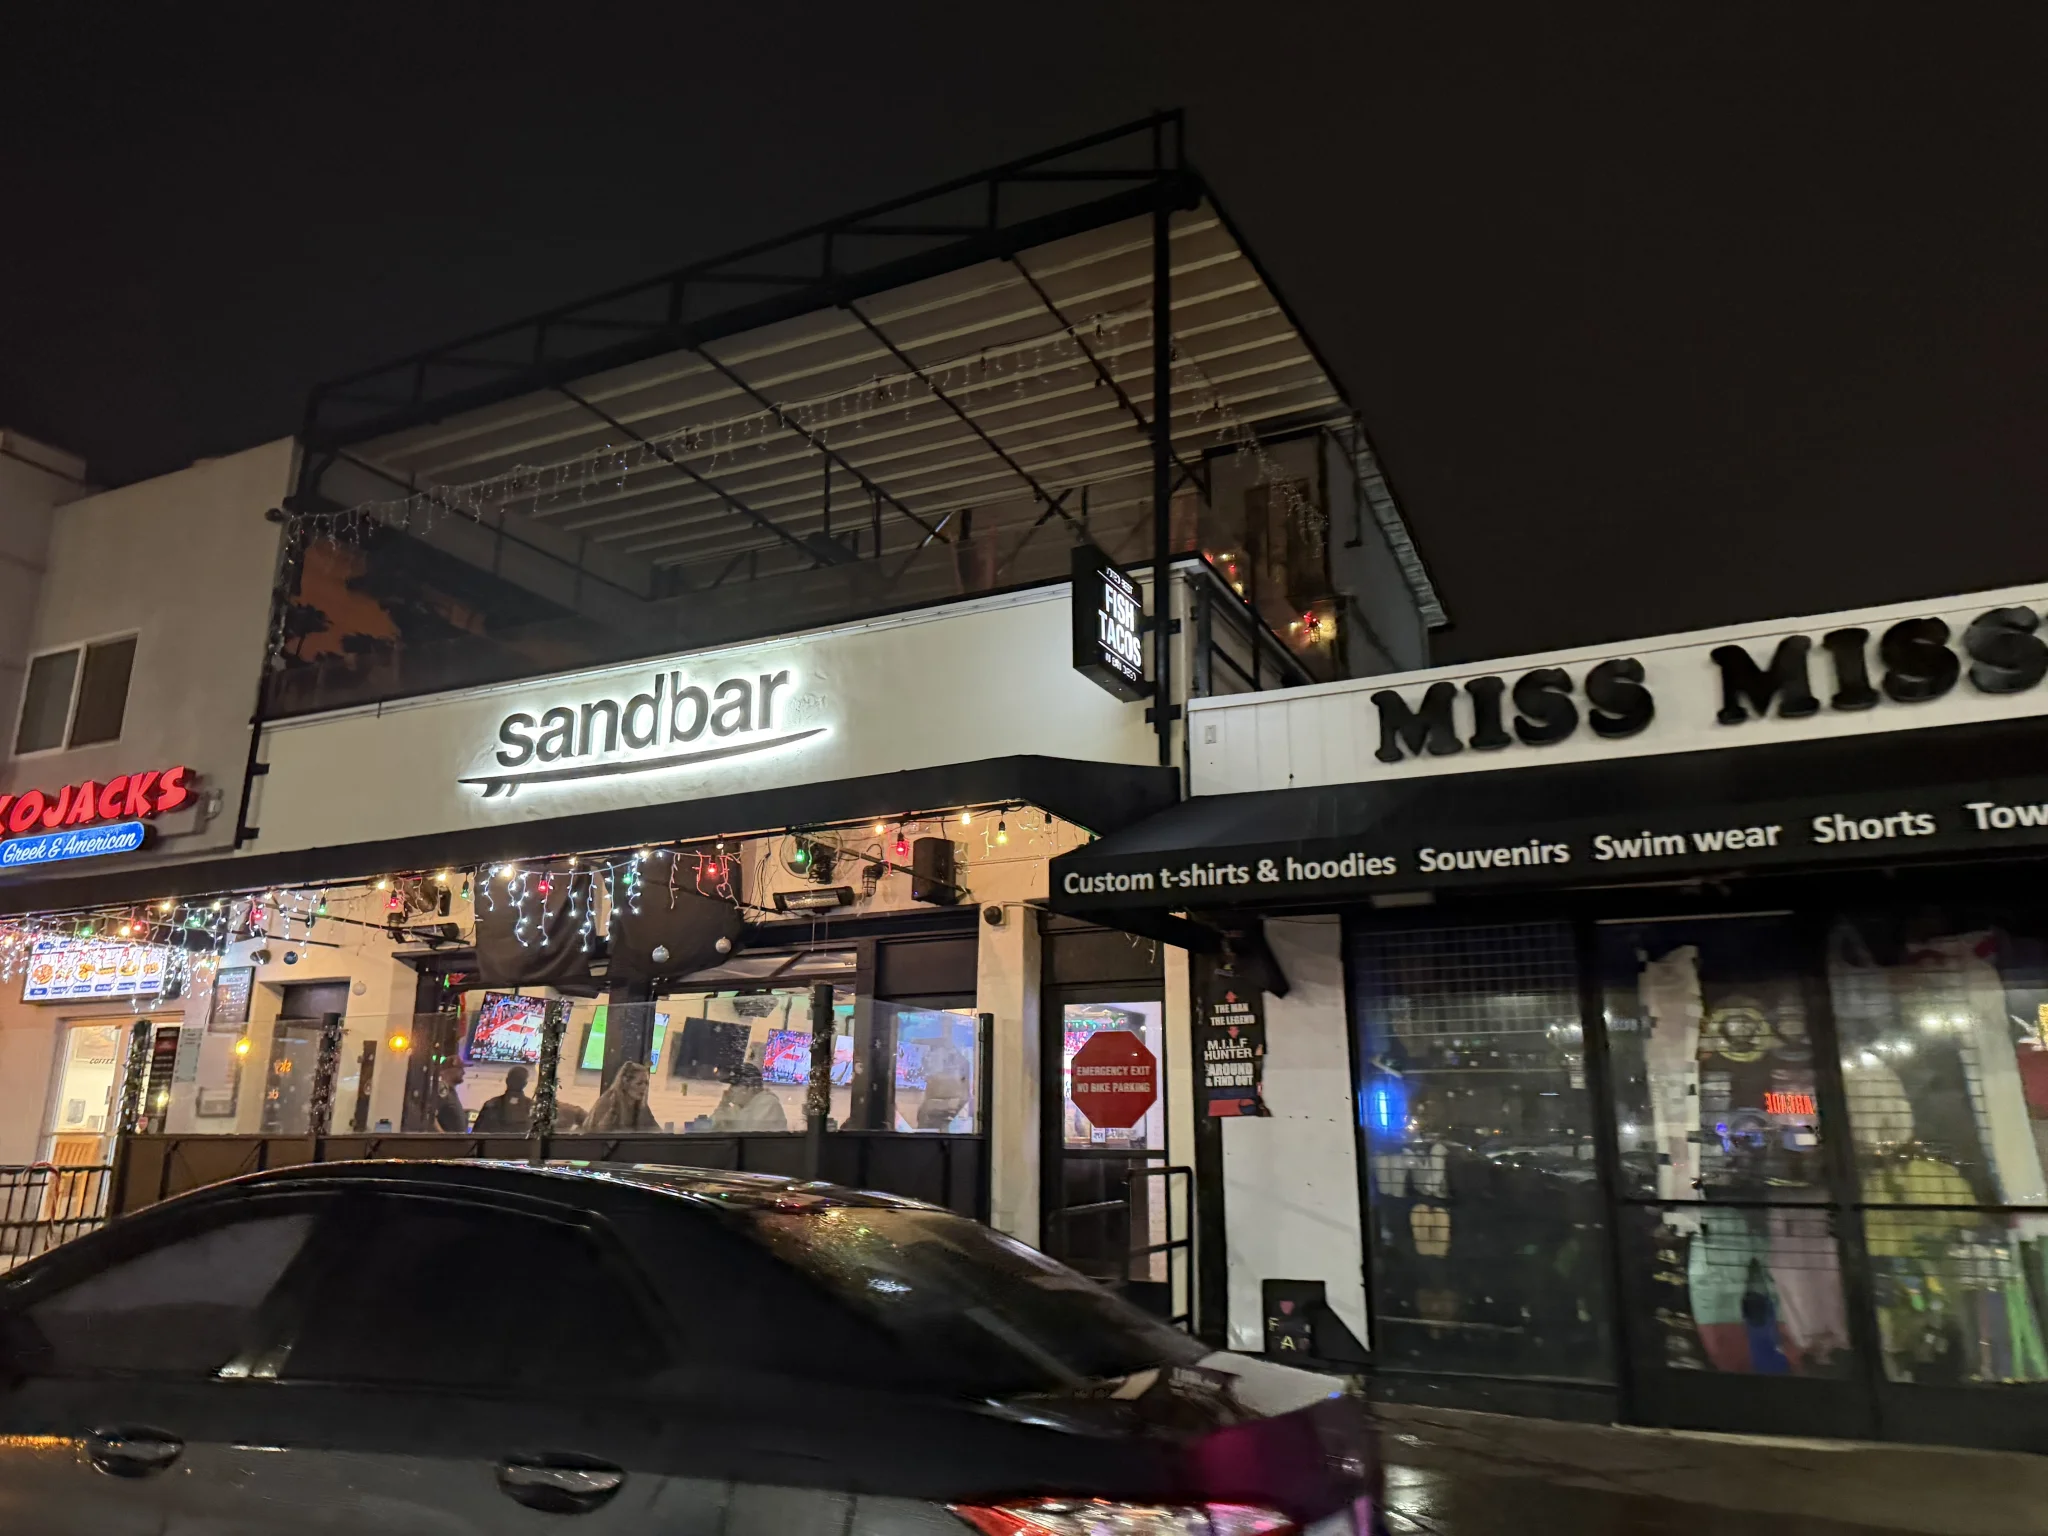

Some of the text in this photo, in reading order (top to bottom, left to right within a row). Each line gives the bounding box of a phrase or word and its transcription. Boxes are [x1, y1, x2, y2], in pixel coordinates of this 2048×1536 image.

[1105, 583, 1135, 632] FISH
[1098, 609, 1142, 668] TACOS
[1370, 657, 1654, 763] MISS
[496, 670, 790, 767] sandbar
[3, 831, 137, 864] Greek & American
[1064, 802, 2048, 895] Custom t-shirts & hoodies Souvenirs Swim wear Shorts Tow
[1214, 1004, 1230, 1014] THE
[1210, 1015, 1255, 1026] THE LEGEND
[1204, 1048, 1253, 1061] HUNTER
[1077, 1065, 1151, 1076] EMERGENCY EXIT
[1208, 1062, 1254, 1077] AROUND
[1077, 1082, 1151, 1093] NO BIKE PARKING
[1213, 1075, 1235, 1087] FIND
[1235, 1074, 1254, 1086] OUT
